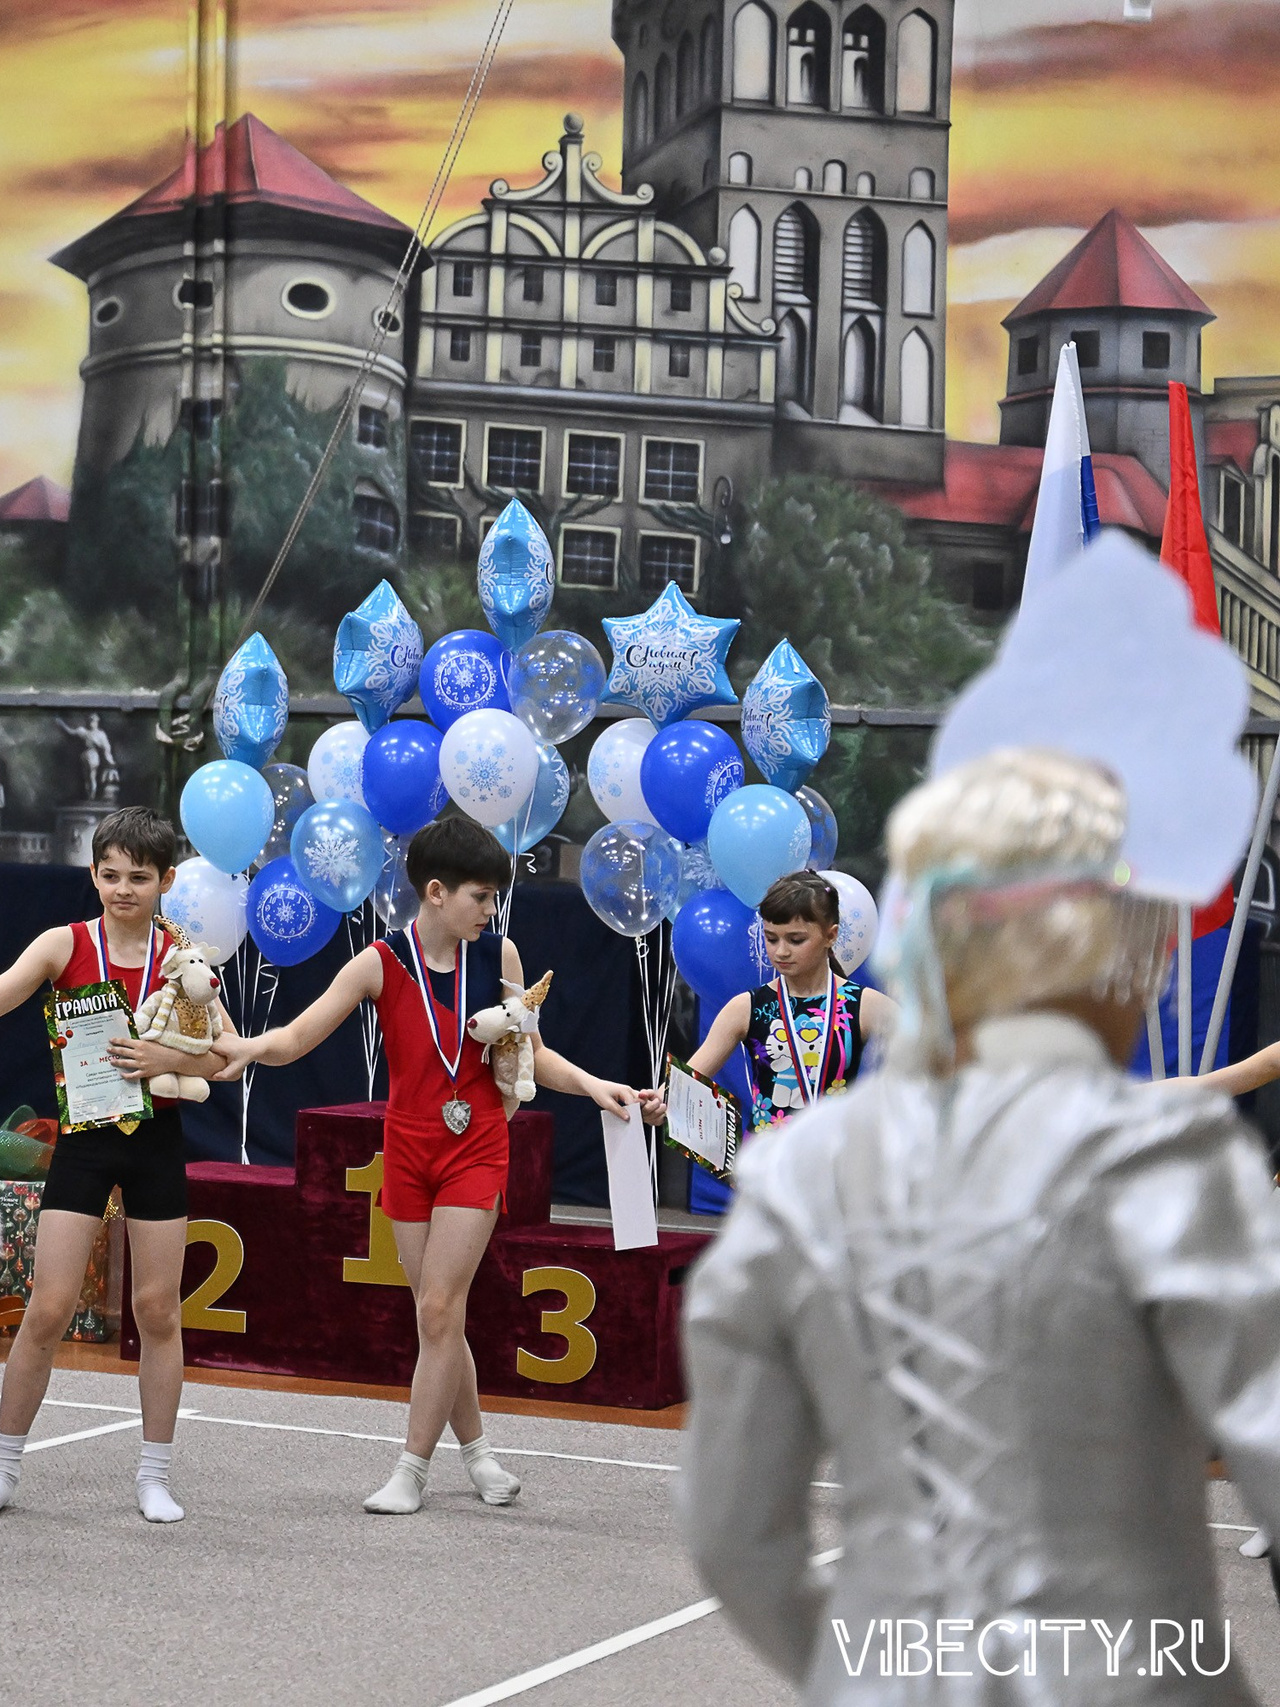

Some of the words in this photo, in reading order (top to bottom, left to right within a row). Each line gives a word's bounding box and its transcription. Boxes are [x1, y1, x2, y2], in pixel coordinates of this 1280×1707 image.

[55, 992, 118, 1019] ГРАМОТА
[725, 1103, 737, 1171] ГРАМОТА
[181, 1219, 247, 1334] 2
[343, 1152, 410, 1287] 1
[517, 1266, 598, 1385] 3
